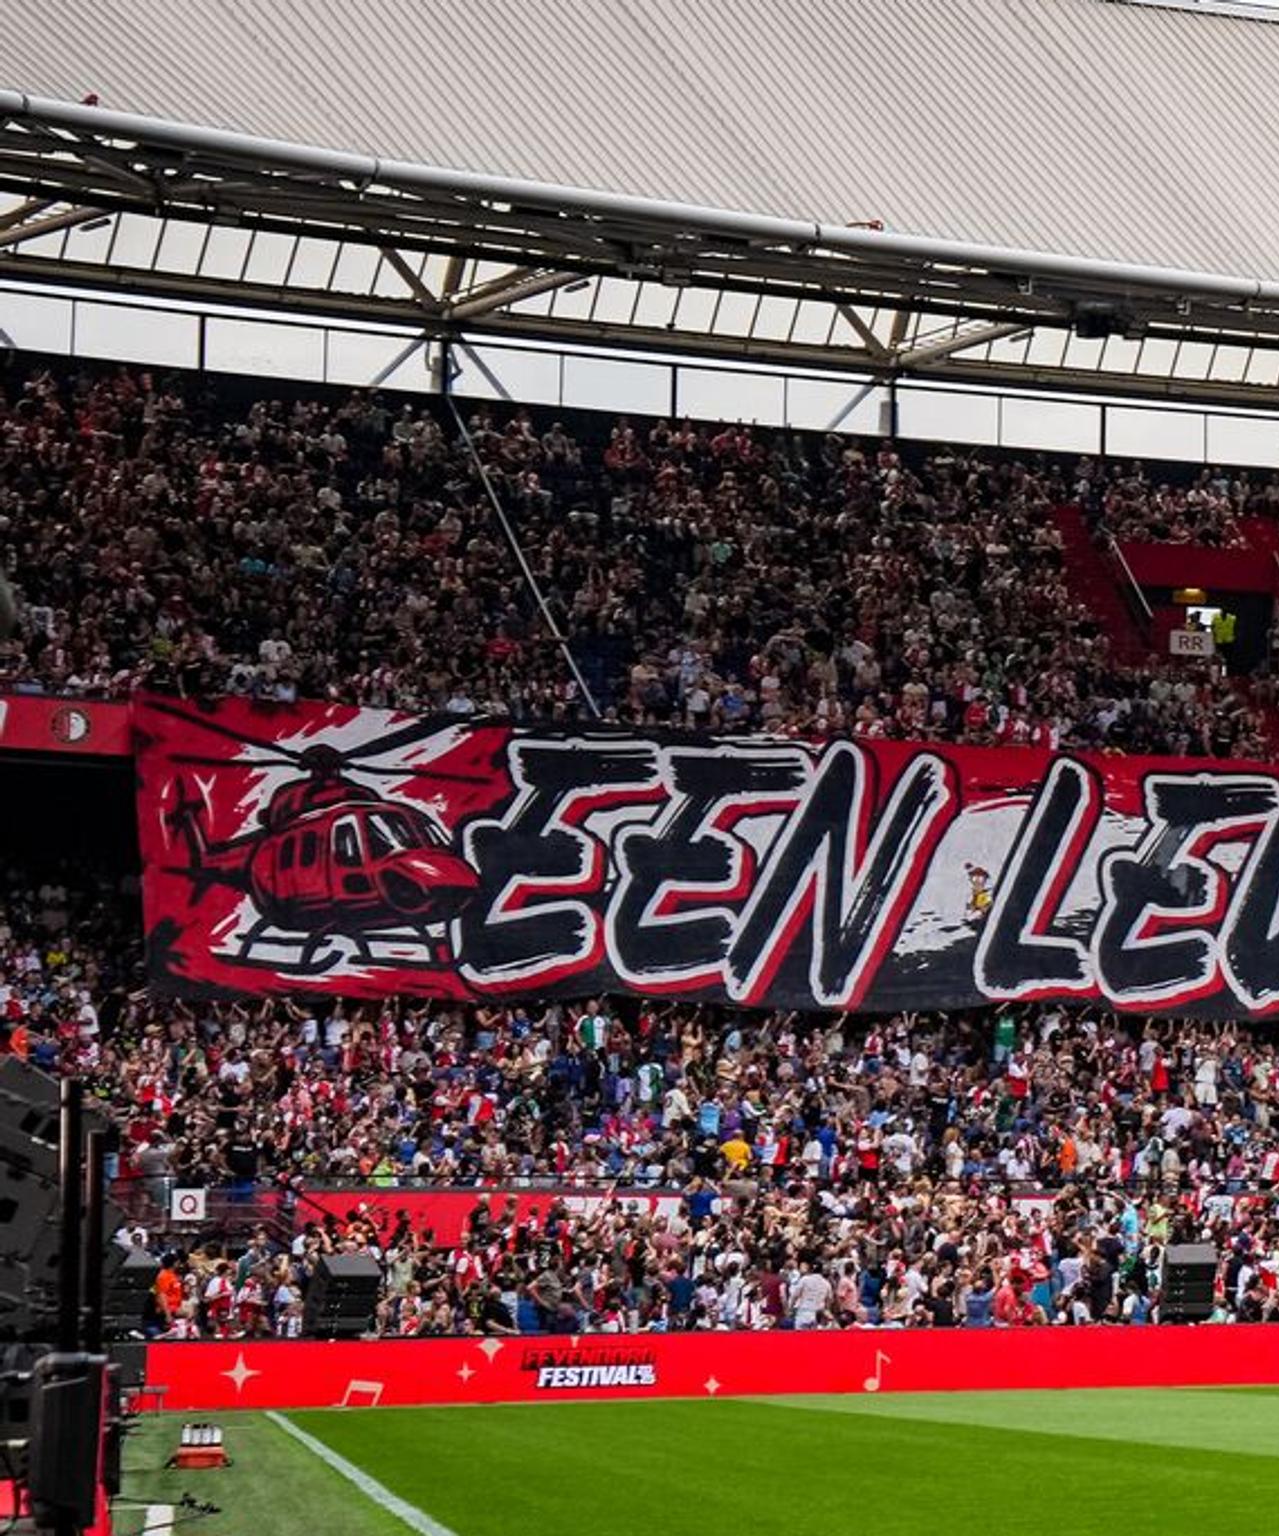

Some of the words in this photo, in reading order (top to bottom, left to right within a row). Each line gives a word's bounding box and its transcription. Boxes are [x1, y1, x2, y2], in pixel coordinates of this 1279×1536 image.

[1178, 635, 1204, 650] RR
[455, 738, 953, 1011] EEN
[180, 1195, 198, 1214] Q
